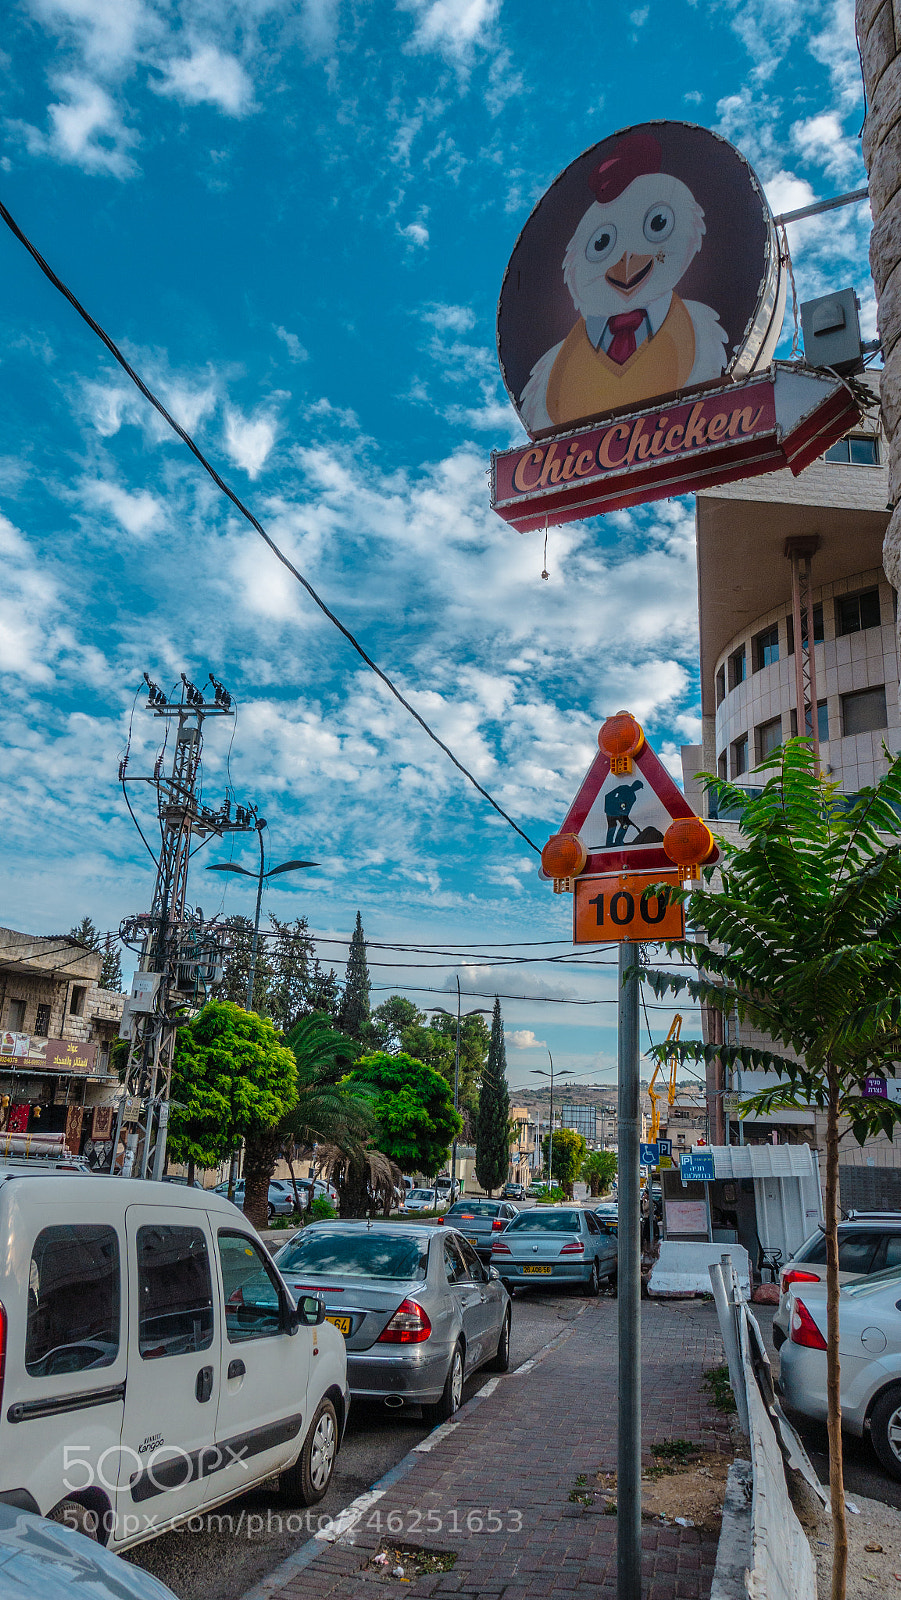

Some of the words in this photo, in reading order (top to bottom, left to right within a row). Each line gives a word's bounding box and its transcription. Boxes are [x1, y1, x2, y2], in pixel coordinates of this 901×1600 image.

[596, 402, 765, 470] Chicken
[588, 891, 668, 926] 100
[138, 1438, 165, 1454] Kangoo
